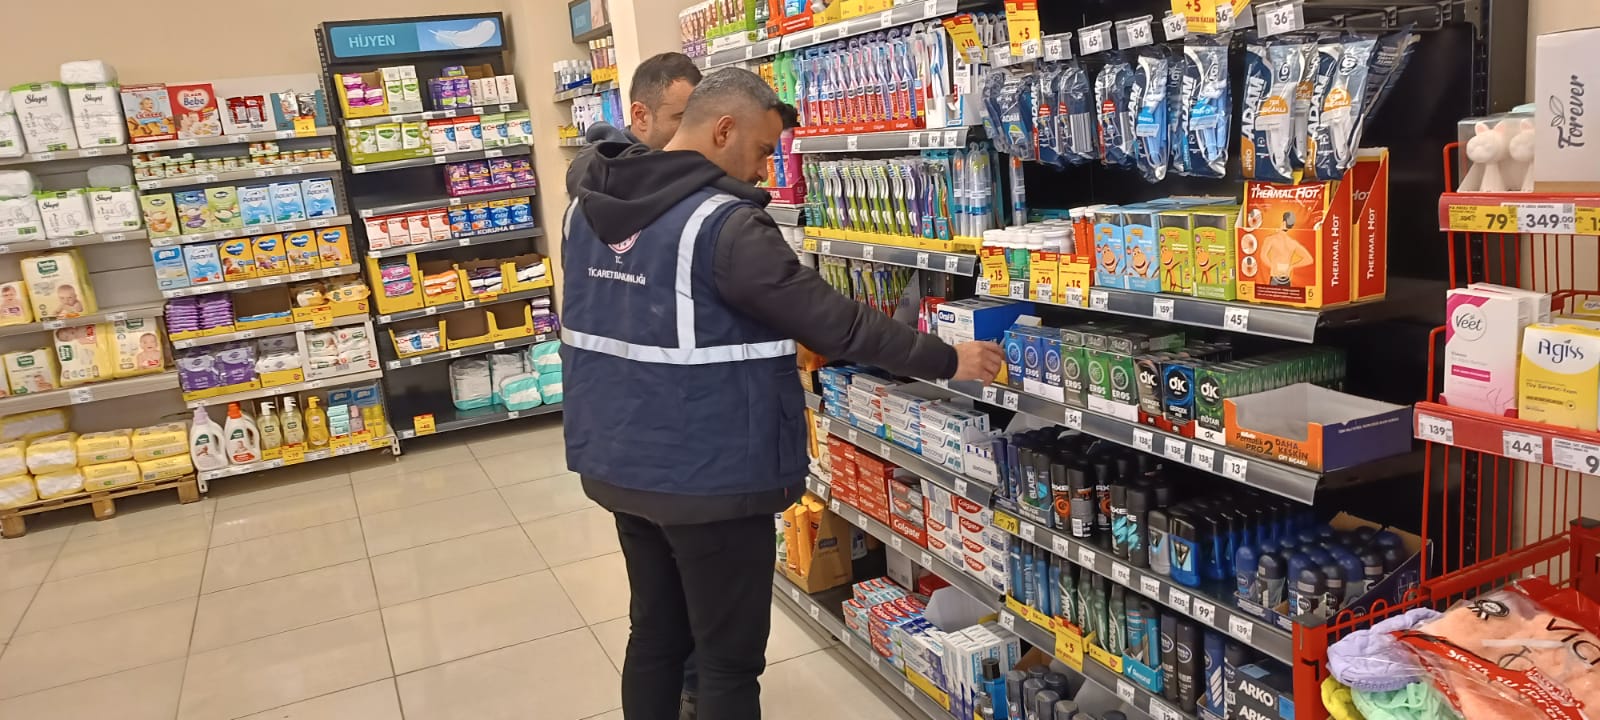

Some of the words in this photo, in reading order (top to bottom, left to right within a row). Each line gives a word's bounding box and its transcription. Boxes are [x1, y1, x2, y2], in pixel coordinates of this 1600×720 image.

[1274, 12, 1288, 24] 36
[1134, 28, 1144, 38] 36
[1170, 20, 1181, 32] 36
[348, 33, 396, 49] HİJYEN
[1019, 28, 1030, 40] +5
[1089, 36, 1098, 46] 65
[1026, 44, 1034, 54] 65
[1050, 44, 1059, 54] 65
[184, 97, 204, 106] Bebe
[1242, 76, 1265, 140] ADAM
[1251, 184, 1294, 198] THERMAL
[1295, 186, 1320, 199] HOT
[1331, 214, 1340, 238] HOT
[1367, 208, 1376, 230] HOT
[1486, 214, 1508, 230] 79
[1331, 238, 1340, 286] THERMAL
[1366, 233, 1374, 280] THERMAL
[1230, 314, 1242, 324] 45
[1456, 312, 1482, 332] Veet
[1538, 339, 1584, 364] Agiss
[1069, 415, 1078, 424] 54
[1429, 424, 1446, 436] 139
[1246, 444, 1264, 454] PRO
[1264, 440, 1274, 456] 2
[1275, 438, 1298, 450] DAHA
[1512, 440, 1532, 454] 44
[1278, 446, 1308, 460] KESKİN
[1232, 464, 1240, 474] 13
[1027, 472, 1038, 498] BLADE
[894, 519, 920, 539] Colgate
[1007, 521, 1014, 530] 79
[1199, 607, 1209, 618] 99
[1240, 680, 1274, 706] ARKO
[1240, 706, 1272, 720] ARK
